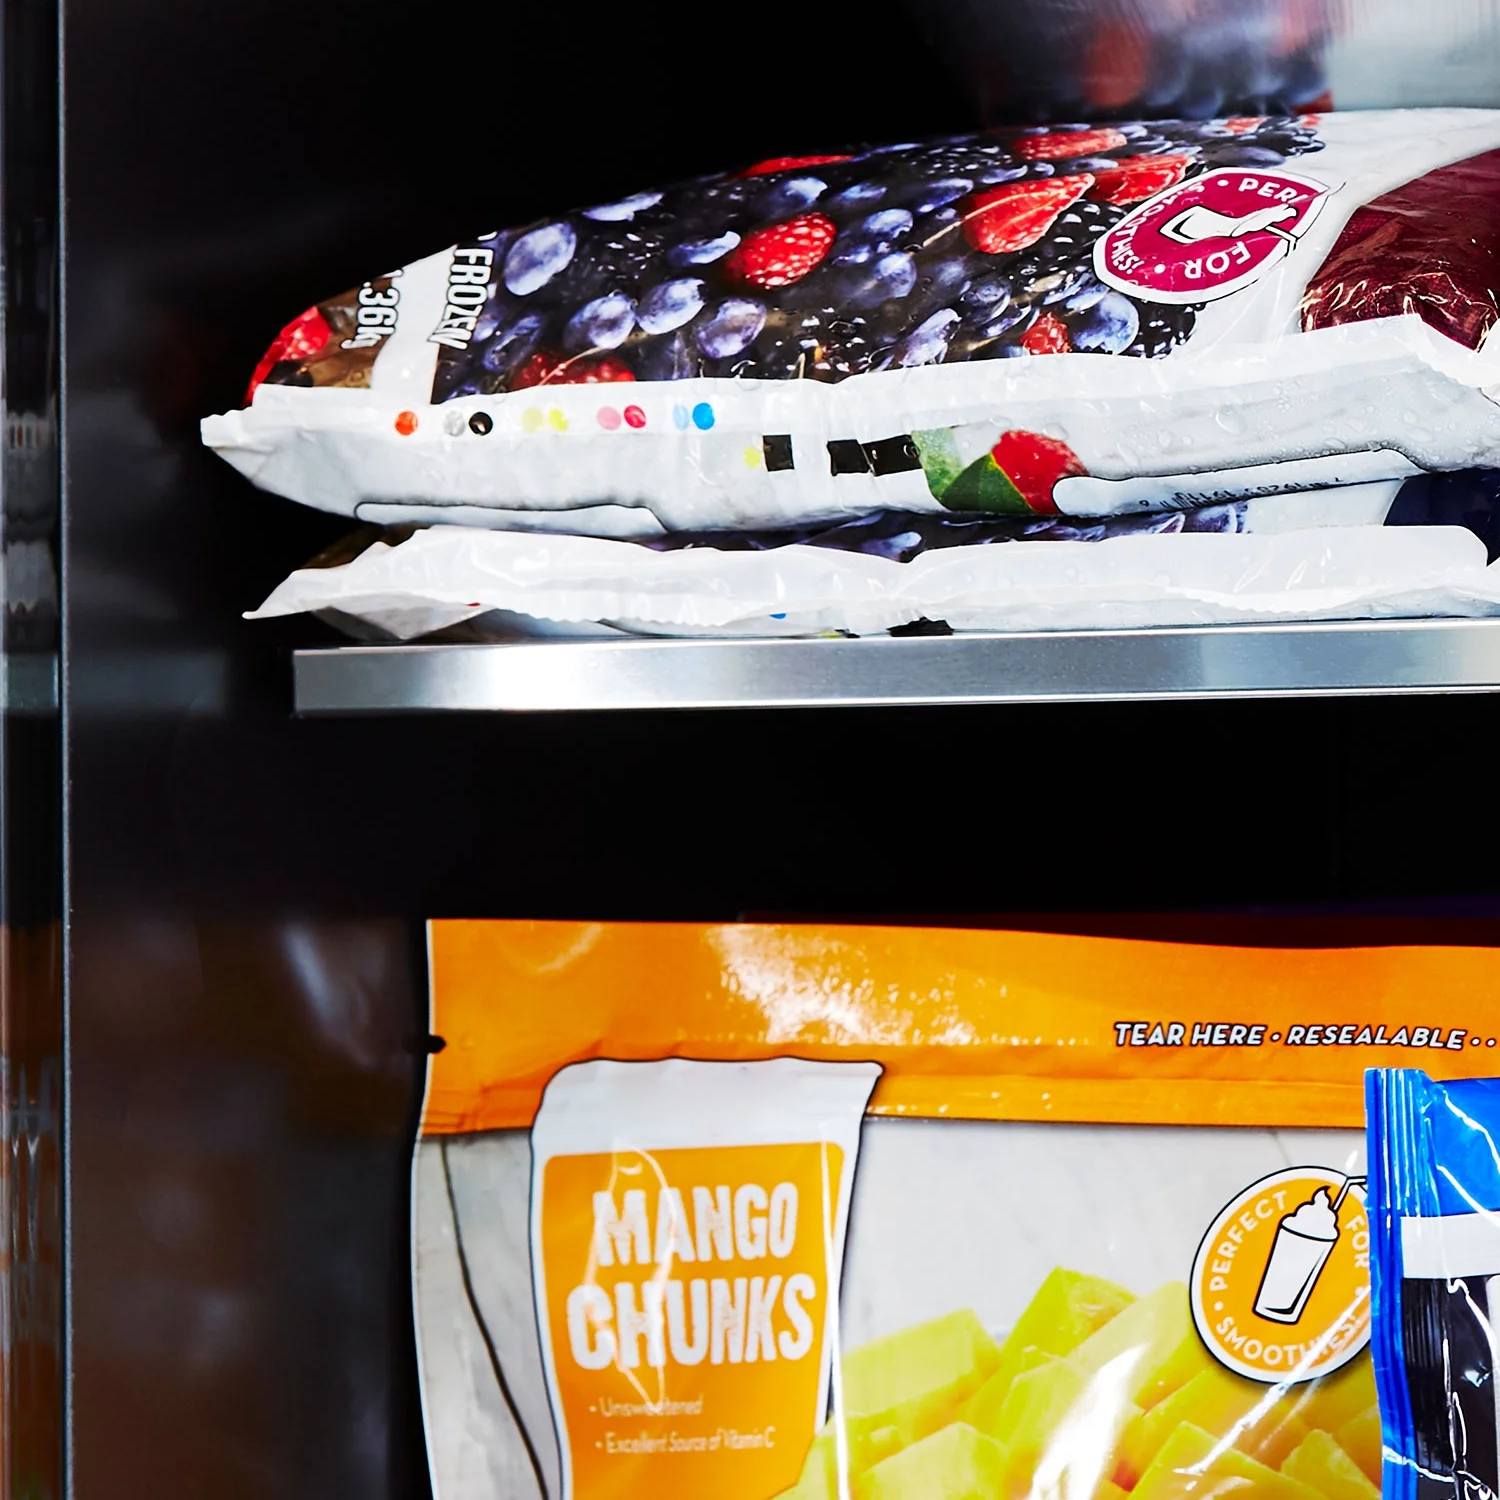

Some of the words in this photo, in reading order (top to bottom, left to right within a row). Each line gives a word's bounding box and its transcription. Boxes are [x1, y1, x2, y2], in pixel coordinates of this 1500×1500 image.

[427, 248, 494, 350] FROZEN
[1184, 241, 1251, 279] FOR
[1114, 1022, 1185, 1046] TEAR
[1191, 1023, 1266, 1046] HERE
[1286, 1025, 1467, 1051] RESEALABLE
[592, 1182, 798, 1267] MANGO
[1210, 1190, 1288, 1292] PERFECT
[566, 1273, 816, 1370] CHUNKS
[764, 1426, 776, 1448] C
